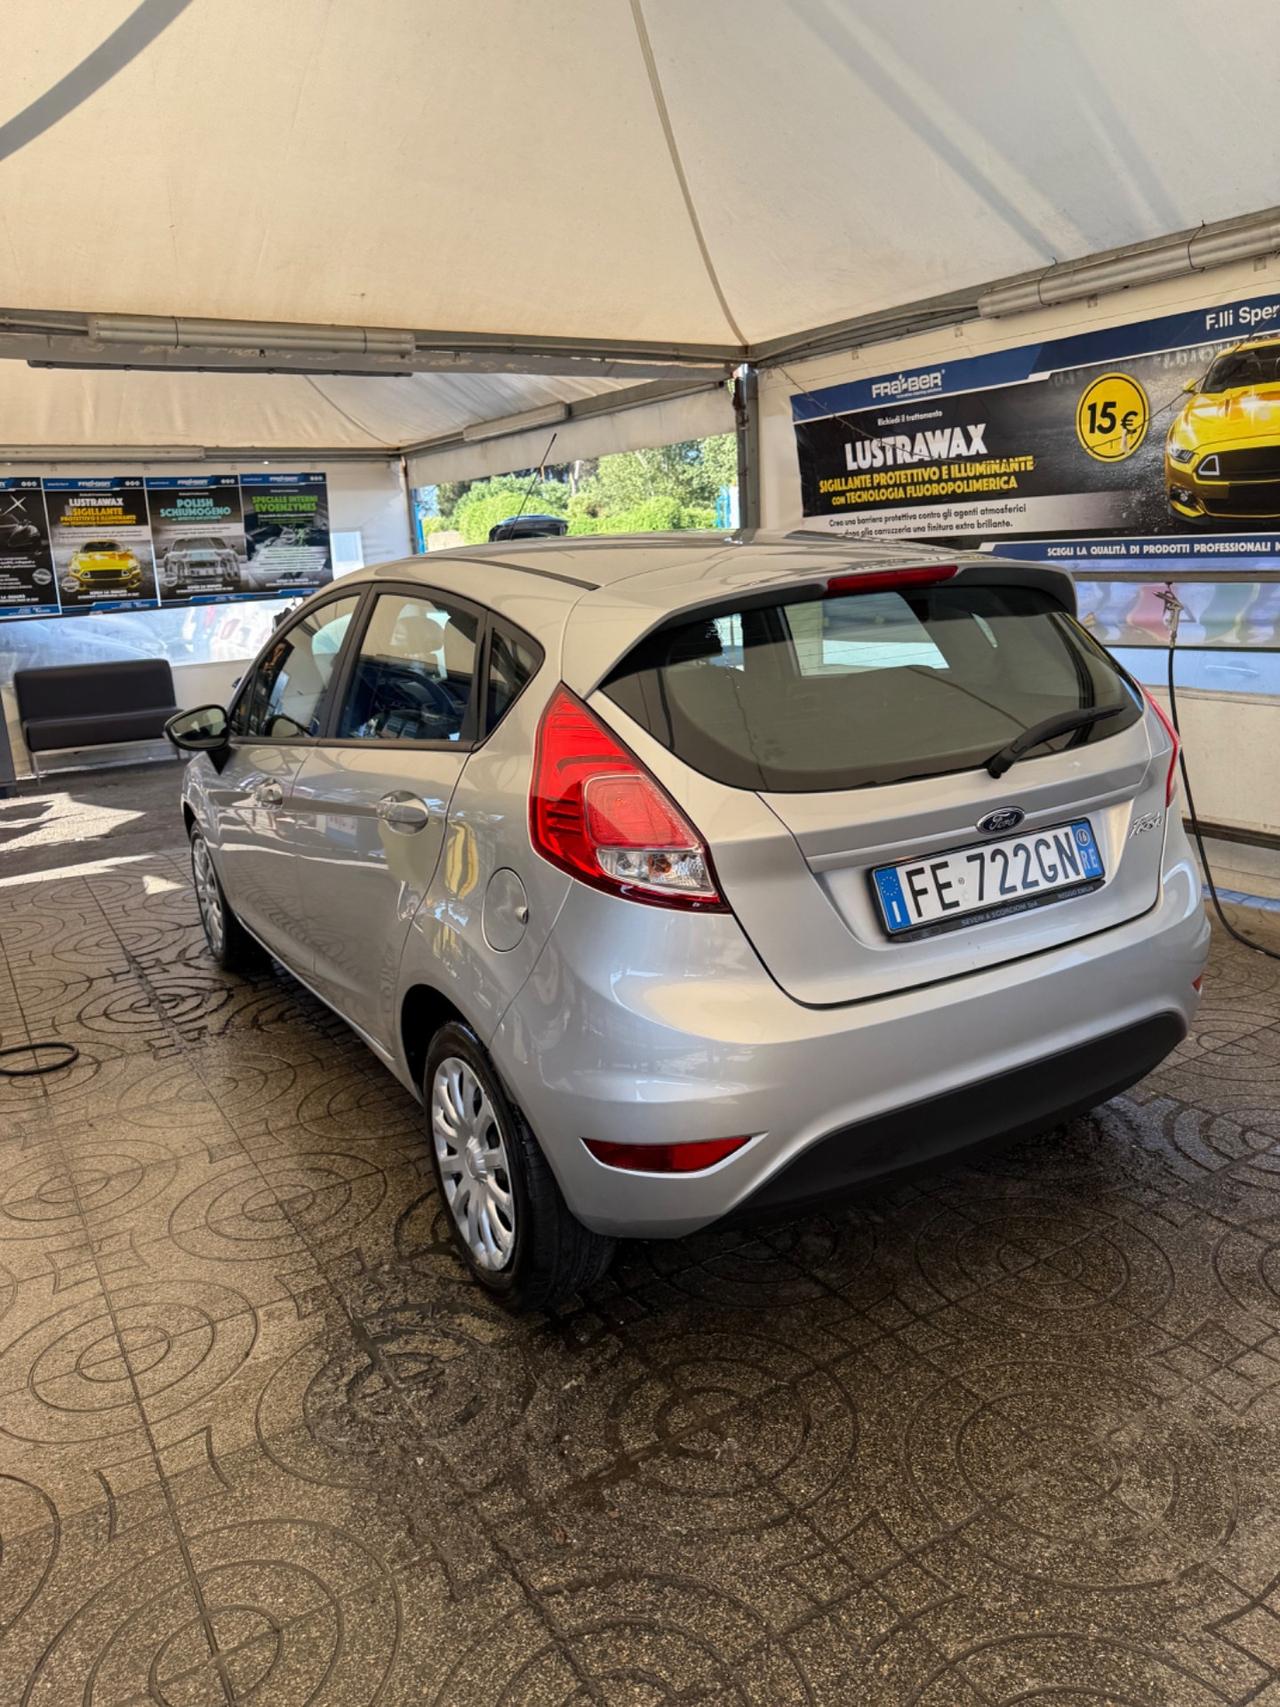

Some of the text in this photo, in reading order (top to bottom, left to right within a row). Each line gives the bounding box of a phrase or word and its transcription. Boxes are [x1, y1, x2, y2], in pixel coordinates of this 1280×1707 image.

[906, 410, 943, 422] trattamento
[844, 423, 988, 471] LUSTRAWAX
[819, 455, 1034, 493] SIGILLANTE PROTETTIVO E ILLUMINANTE
[846, 486, 905, 504] TECNOLOGIA
[906, 475, 1018, 498] FLUOROPOLIMERICA
[68, 498, 124, 507] LUSTRAWAX
[72, 507, 123, 515] SIGILLANTE
[176, 498, 213, 508] POLISH
[829, 519, 844, 527] Crea
[857, 515, 883, 525] barriera
[884, 511, 917, 524] protettiva
[918, 511, 941, 520] contro
[942, 508, 952, 520] gli
[954, 508, 978, 519] agenti
[980, 503, 1026, 515] atmosferici
[874, 525, 912, 535] carrozzeria
[927, 522, 954, 532] finitura
[955, 521, 975, 530] extra
[977, 519, 1013, 529] brillante.
[1047, 546, 1074, 557] SCEGLI
[1077, 546, 1087, 555] LA
[1090, 543, 1127, 555] QUALITÀ
[1130, 545, 1139, 554] DI
[1143, 544, 1190, 554] PRODOTTI
[1194, 541, 1271, 553] PROFESSIONALI
[1080, 848, 1099, 870] RE
[905, 832, 1081, 918] FE 722GN
